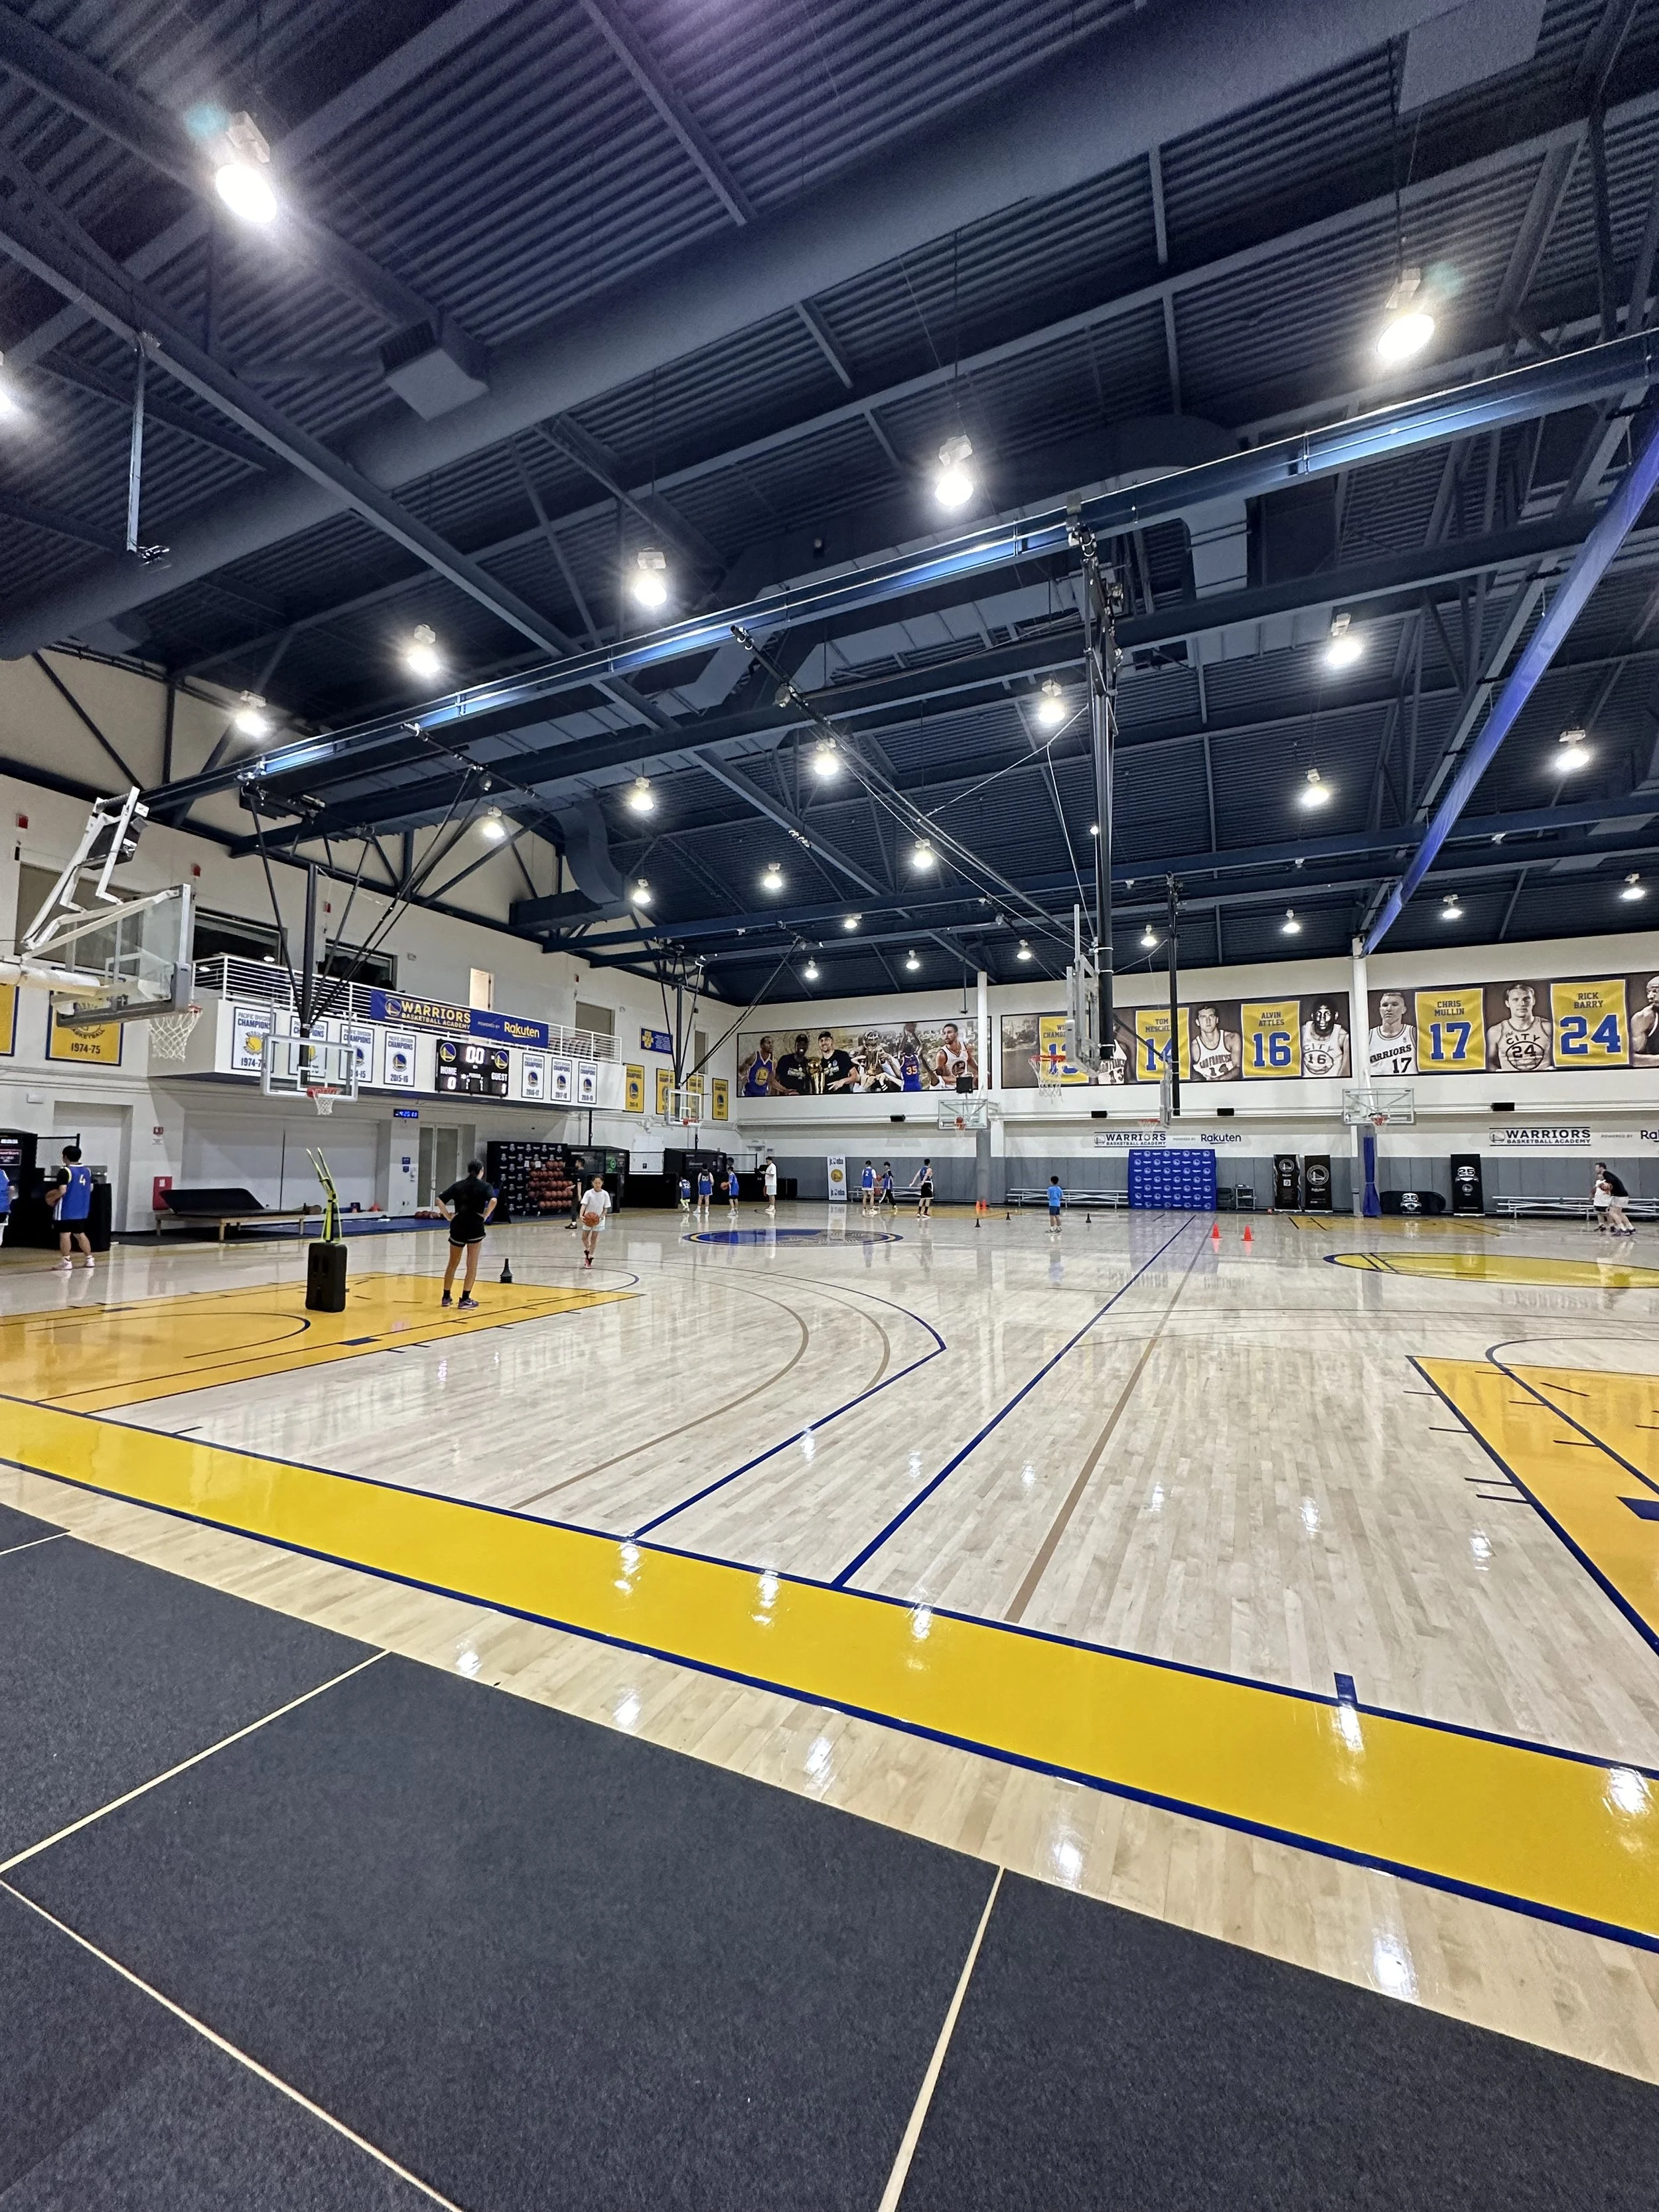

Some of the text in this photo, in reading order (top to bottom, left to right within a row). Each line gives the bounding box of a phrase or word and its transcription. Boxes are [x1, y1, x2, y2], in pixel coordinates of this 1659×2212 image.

[1577, 992, 1599, 1000] RICK
[1573, 1000, 1604, 1009] BARRY
[401, 1000, 471, 1024] WARRIORS
[1434, 1008, 1465, 1017] MULLIN
[401, 1012, 470, 1030] BASKETBALL ACADEMY
[72, 1028, 106, 1039] ASKETBALL
[504, 1021, 540, 1038] Rakuten
[1559, 1014, 1621, 1055] 24
[344, 1034, 371, 1044] CAMPIONS
[1429, 1021, 1471, 1060] 17
[1506, 1033, 1541, 1045] CITY
[71, 1043, 101, 1054] 1974-75
[388, 1041, 413, 1050] CHAMPIONS
[1253, 1031, 1291, 1067] 16
[1303, 1043, 1334, 1053] CITY
[1512, 1044, 1537, 1058] 24
[466, 1046, 485, 1064] 00
[1307, 1053, 1327, 1065] 16
[440, 1066, 457, 1075] HOME
[906, 1066, 917, 1075] 35
[1392, 1057, 1412, 1074] 17
[390, 1074, 409, 1082] 2015-16
[492, 1072, 508, 1081] GUEST
[1200, 1133, 1242, 1142] Rakuten
[1505, 1129, 1591, 1139] WARRIORS
[1640, 1130, 1659, 1140] Ra
[79, 1174, 86, 1186] 4
